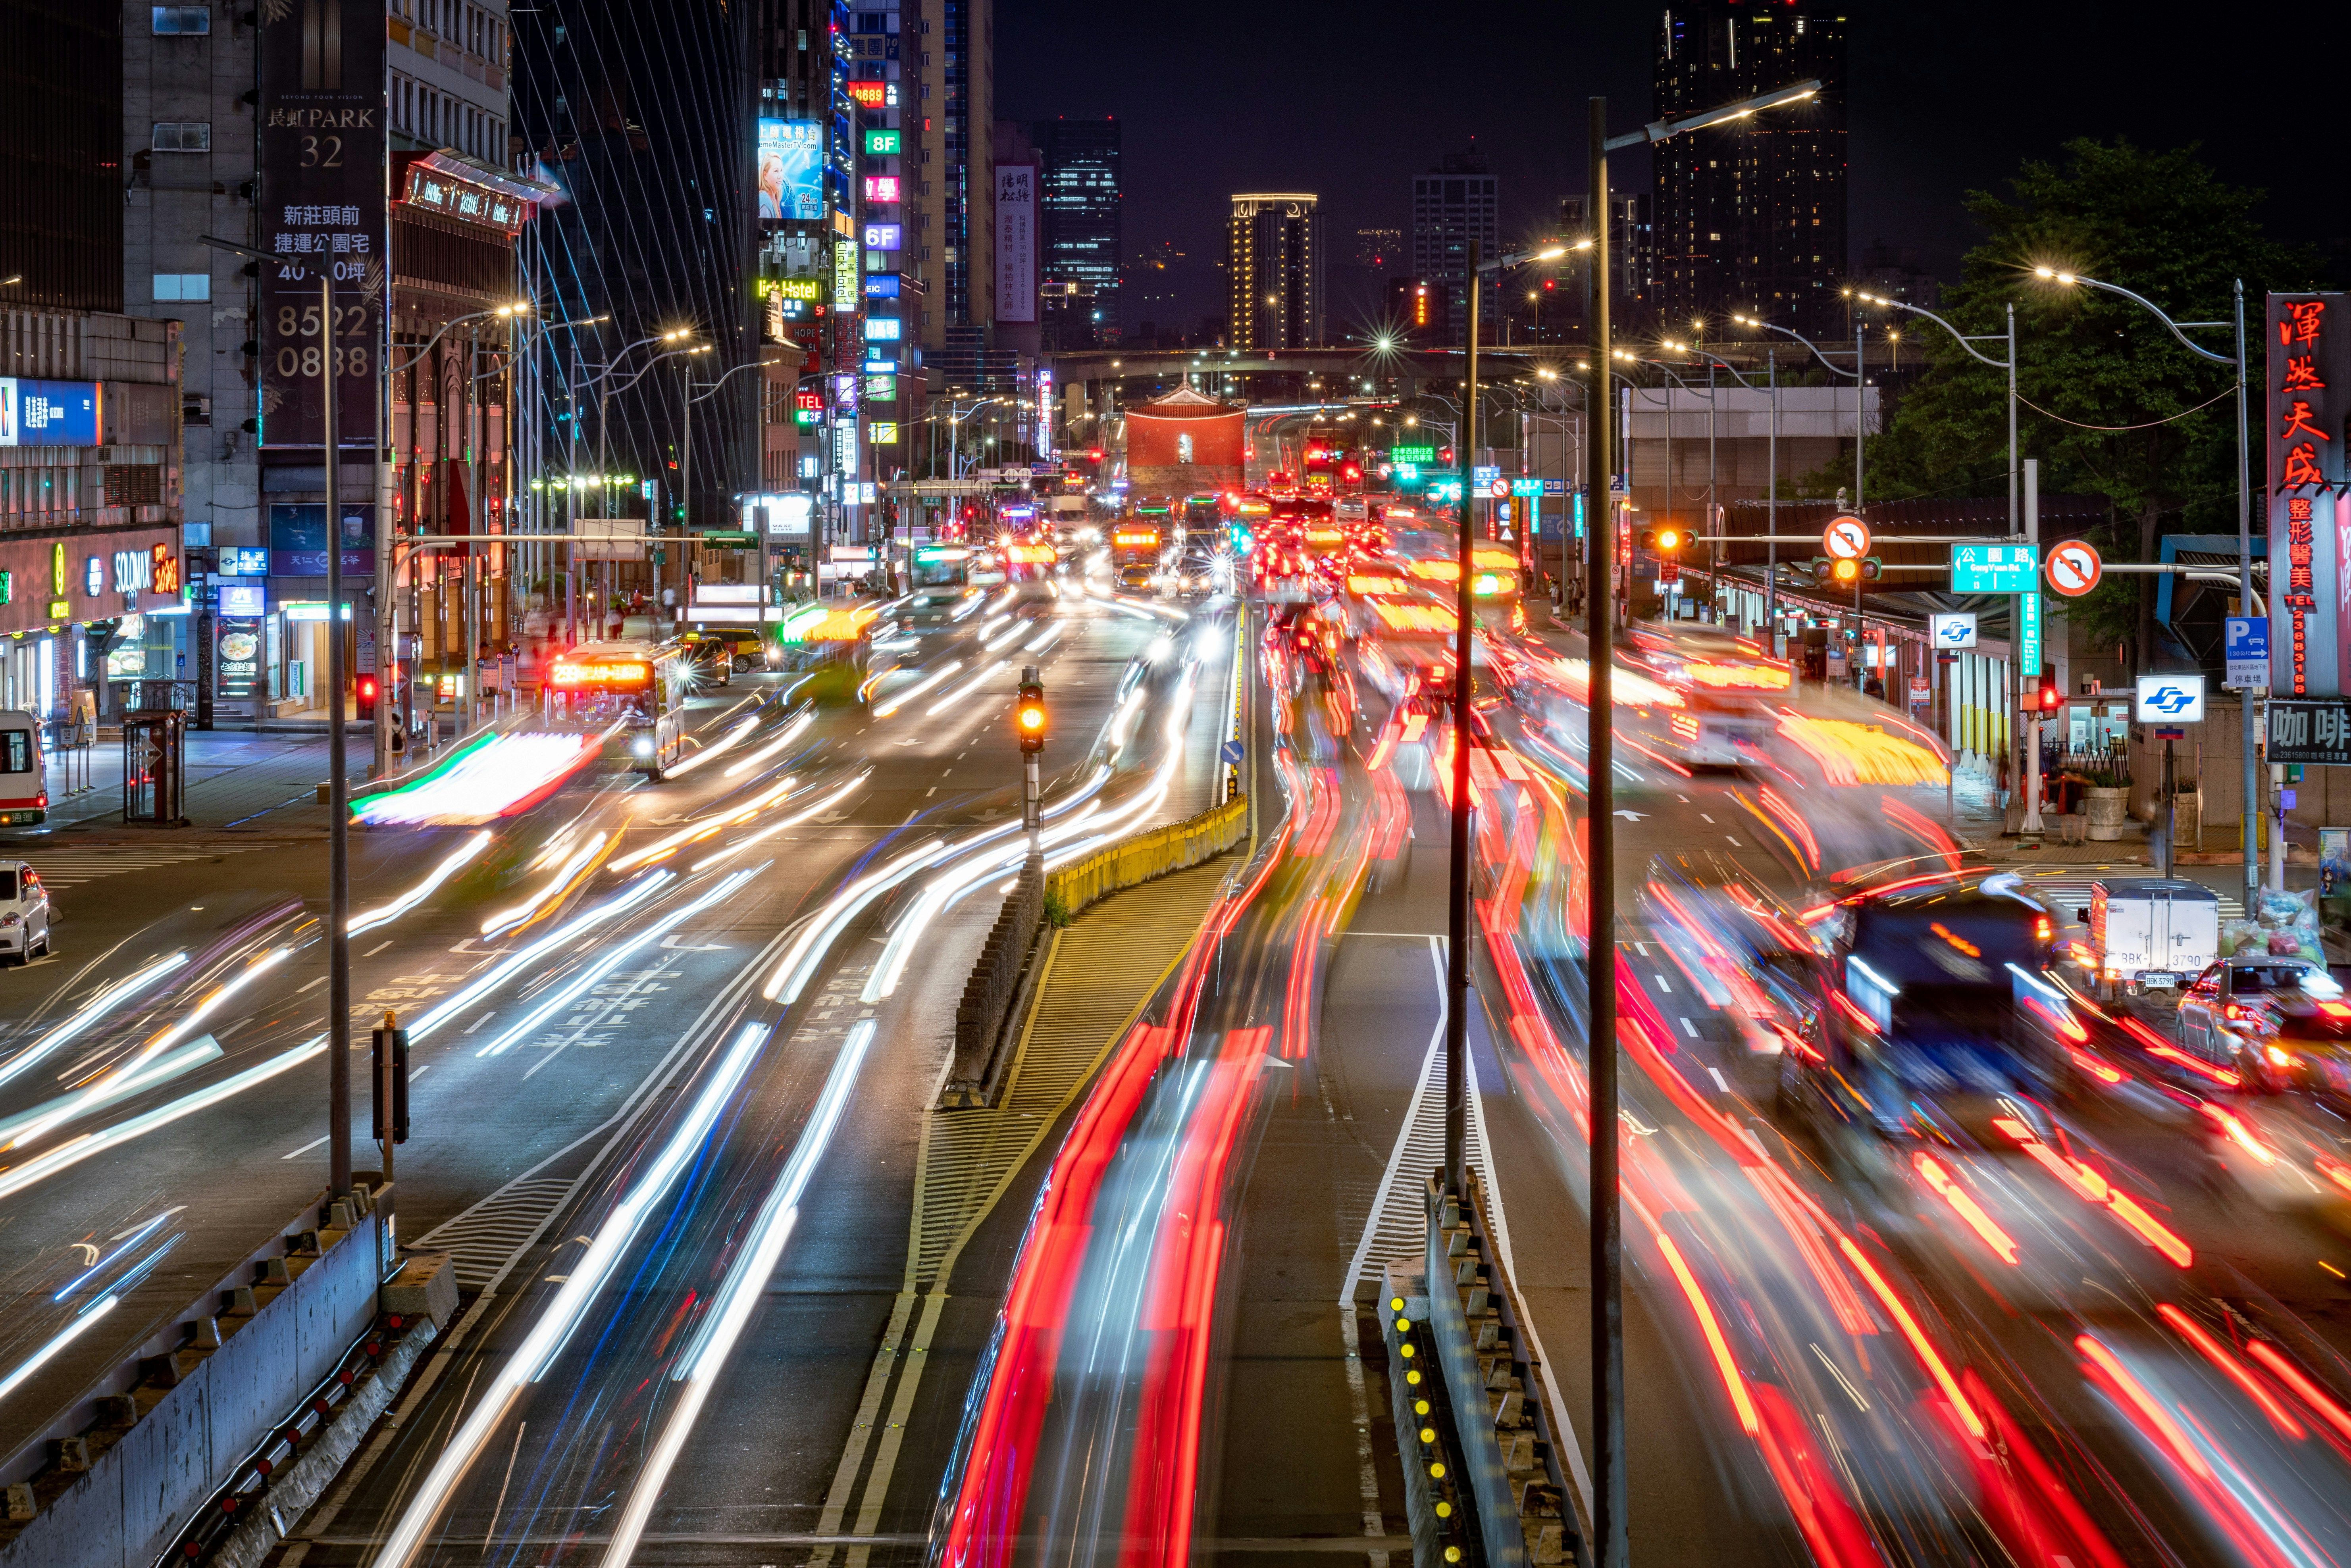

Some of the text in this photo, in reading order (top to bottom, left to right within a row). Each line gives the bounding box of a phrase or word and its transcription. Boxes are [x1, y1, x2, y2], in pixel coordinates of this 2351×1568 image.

[850, 38, 882, 56] 集團
[887, 38, 898, 47] 10
[759, 125, 815, 140] 上師電視台
[300, 135, 343, 167] 32
[759, 141, 816, 149] emeMasterTV.com
[873, 137, 895, 151] 8F
[284, 205, 360, 225] 新莊頭前
[275, 233, 369, 253] 捷運公園宅
[866, 228, 894, 246] 6F
[838, 242, 847, 267] Click
[782, 281, 816, 298] Hotel
[838, 270, 847, 298] Hotel
[1004, 263, 1013, 310] 楊柏林大師
[784, 300, 801, 310] 旅店
[816, 306, 825, 316] 5F
[794, 329, 815, 337] HOPE
[798, 396, 822, 408] TEL
[2279, 301, 2330, 489] 渾然天成
[809, 412, 822, 422] 3F
[845, 431, 853, 462] 巴菲特
[1610, 475, 1618, 485] P
[863, 484, 873, 497] P
[2289, 498, 2311, 588] 整形醫美
[240, 551, 265, 561] 捷運
[291, 556, 313, 565] 天仁
[1961, 547, 2029, 563] 公園路
[116, 550, 150, 593] SOLOMAX
[2228, 621, 2250, 646] P
[2284, 595, 2315, 694] TEL 23883188
[554, 665, 578, 683] 299
[2235, 674, 2261, 684] 停車場
[2272, 706, 2351, 749] 咖啡
[2311, 752, 2348, 761] 咖啡豆專賣
[12, 812, 33, 823] 通運
[2122, 953, 2200, 966] BBK- 3790
